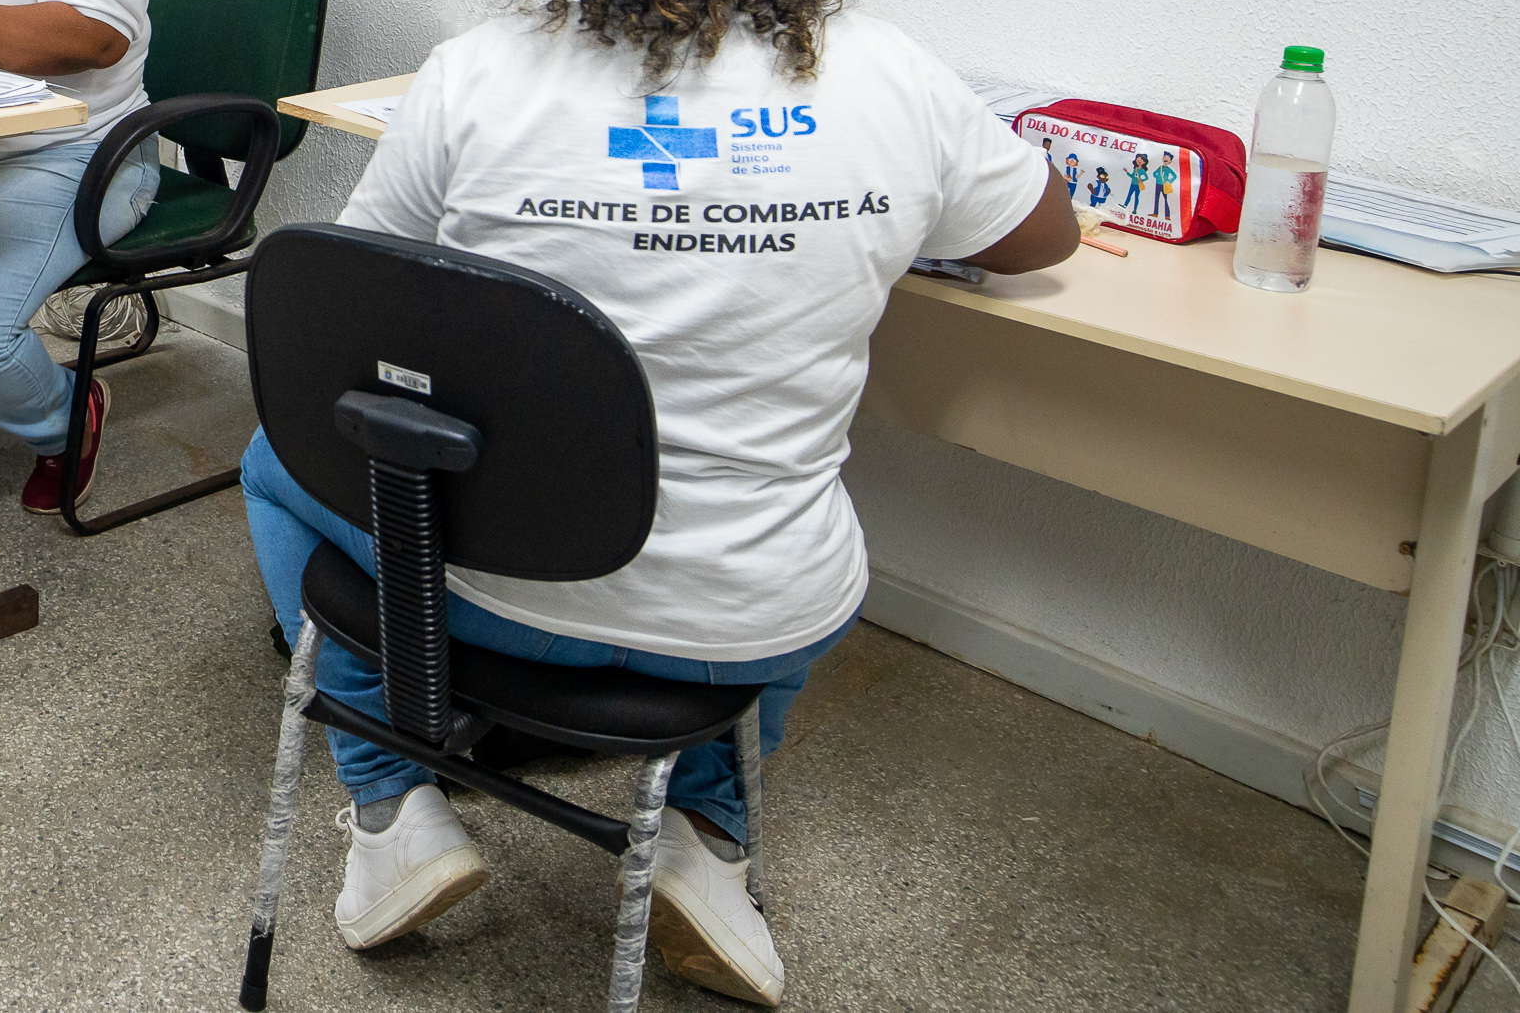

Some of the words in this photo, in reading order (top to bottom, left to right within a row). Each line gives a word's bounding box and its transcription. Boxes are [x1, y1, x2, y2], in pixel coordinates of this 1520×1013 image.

[730, 104, 817, 138] SUS
[1026, 118, 1047, 133] DIA
[1050, 124, 1069, 137] DO
[1071, 130, 1098, 145] ACS
[1099, 136, 1109, 147] E
[1110, 138, 1138, 153] ACE
[731, 142, 783, 152] Sistema
[732, 165, 748, 175] de
[752, 163, 792, 174] Saúde
[515, 197, 638, 222] AGENTE
[651, 203, 691, 224] DE
[702, 199, 850, 224] COMBATE
[856, 190, 891, 215] ÁS
[1146, 218, 1173, 233] BAHIA
[632, 232, 796, 253] ENDEMIAS
